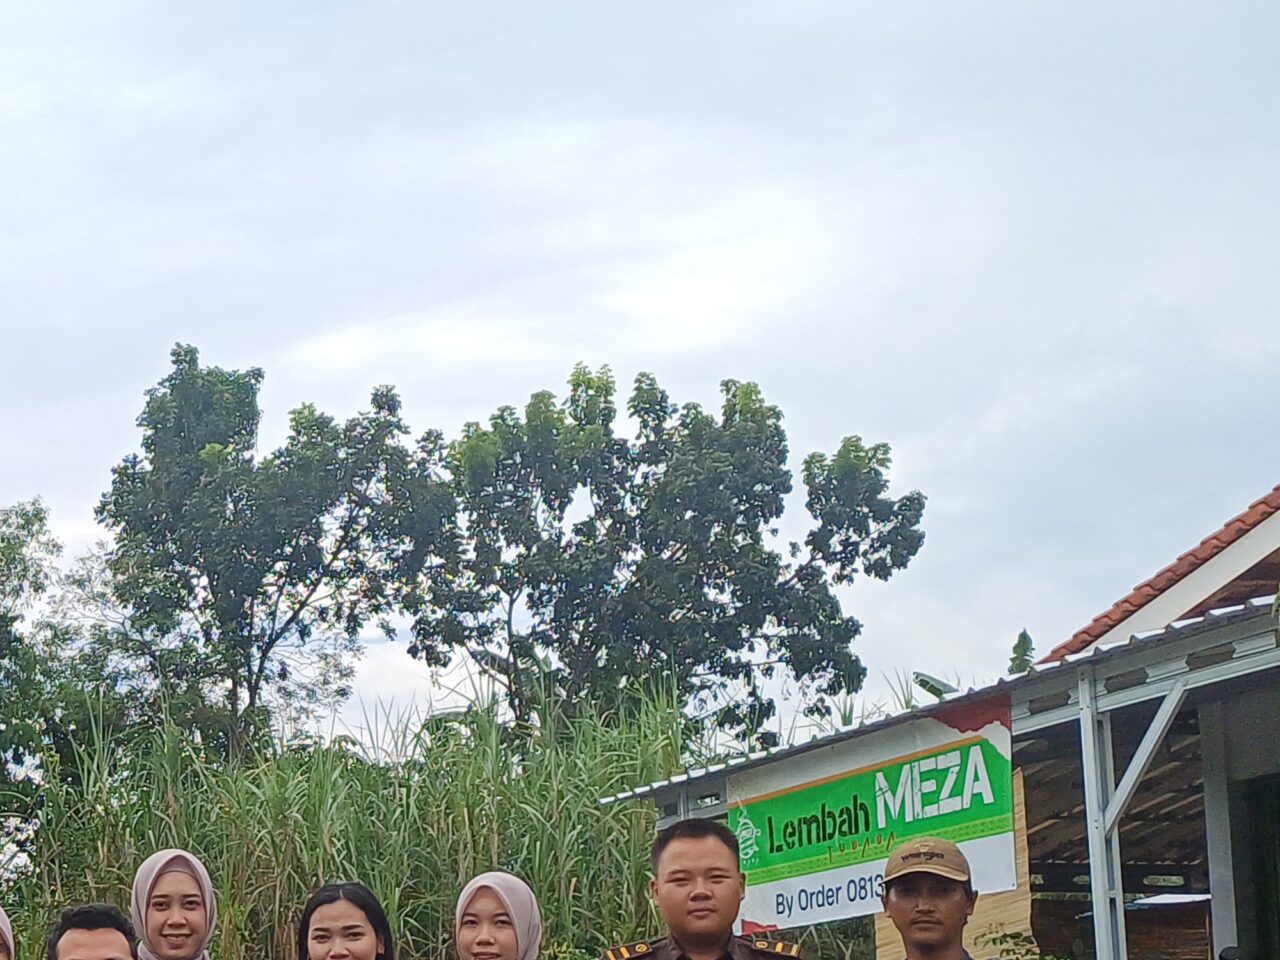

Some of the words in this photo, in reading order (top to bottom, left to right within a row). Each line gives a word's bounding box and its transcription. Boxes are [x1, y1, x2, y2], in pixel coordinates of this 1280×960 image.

[768, 794, 870, 855] Lembah
[874, 745, 995, 830] MEZA
[776, 893, 794, 918] By
[798, 884, 843, 912] Order
